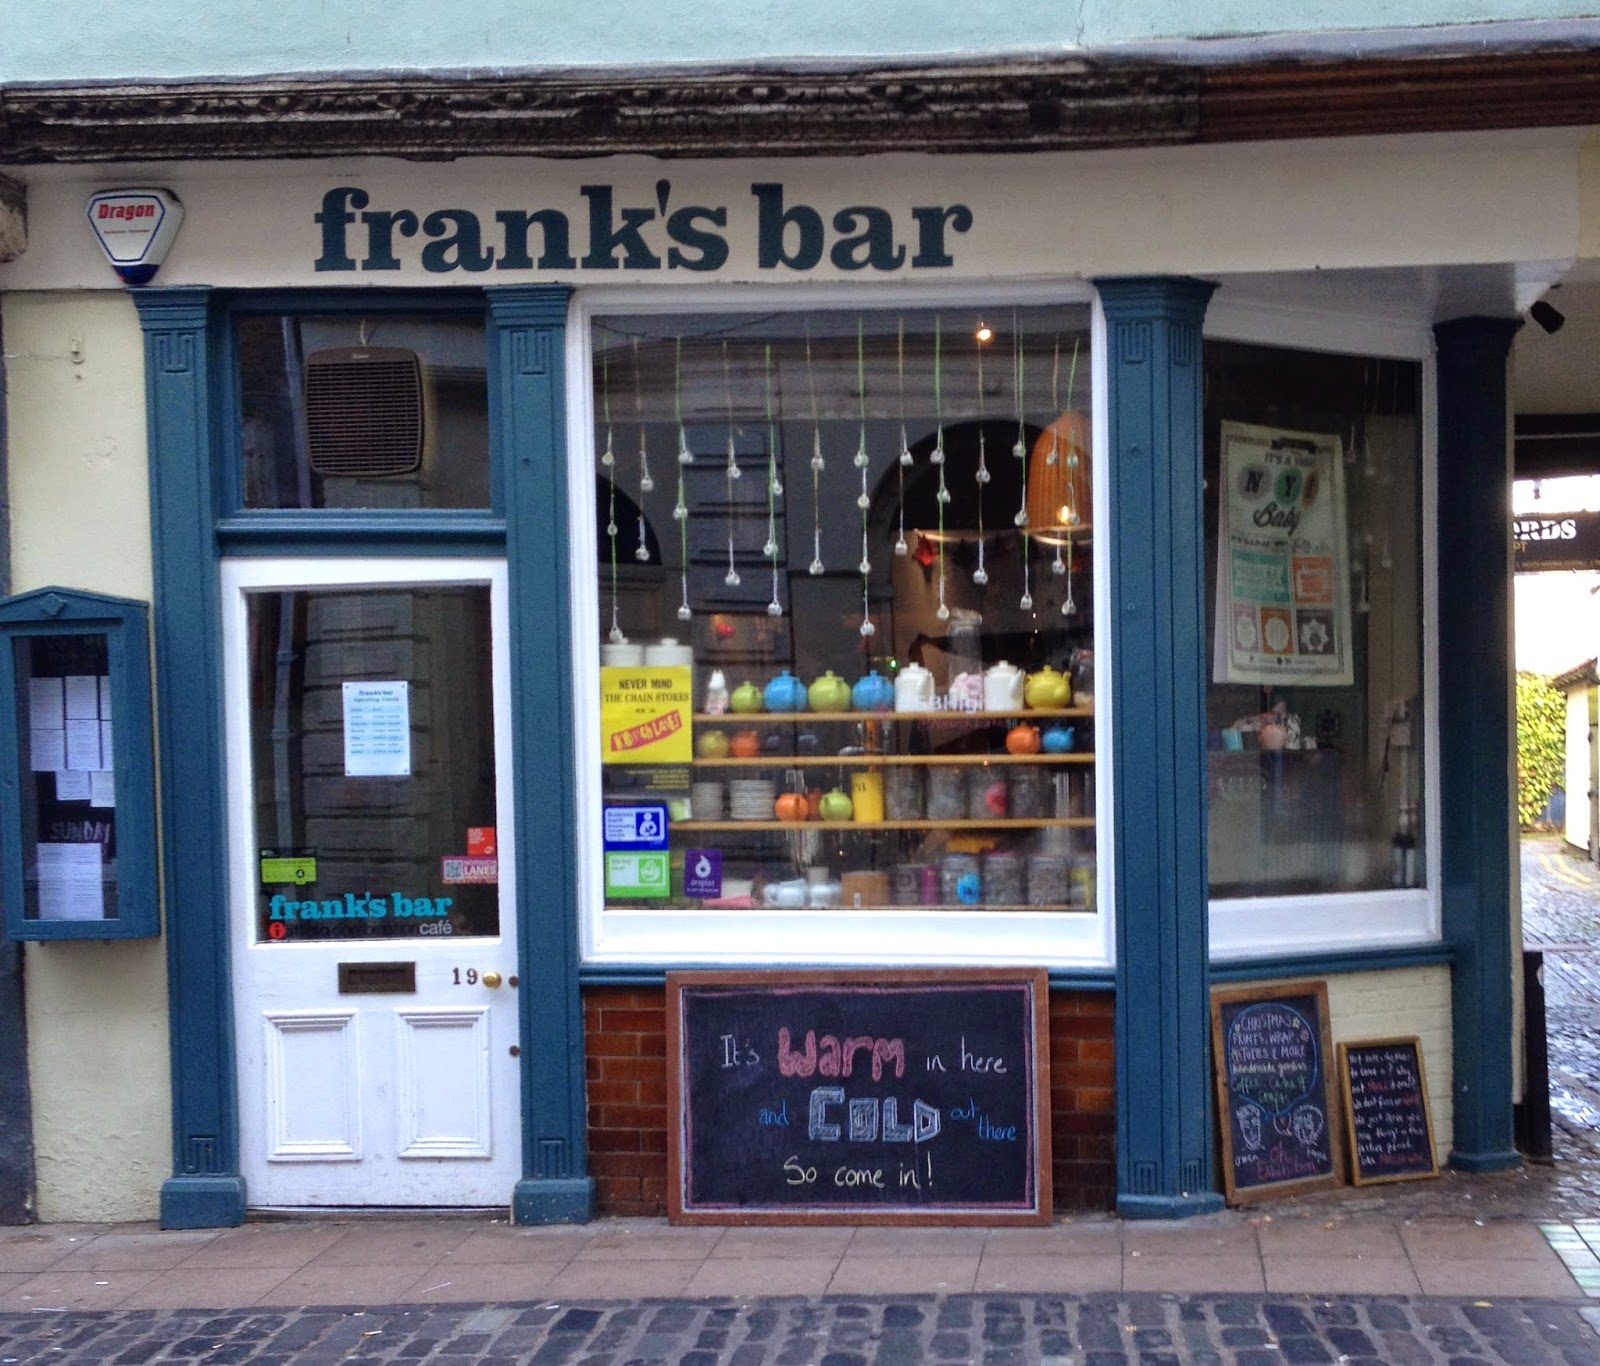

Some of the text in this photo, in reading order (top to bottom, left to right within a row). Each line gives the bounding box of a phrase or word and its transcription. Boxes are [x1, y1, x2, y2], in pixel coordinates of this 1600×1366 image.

[98, 203, 155, 220] Dragon
[314, 178, 973, 272] frank's bar
[619, 678, 673, 690] NEVER MIND
[605, 691, 690, 703] THE CHAIN STORES
[269, 891, 453, 921] frank's bar
[419, 919, 453, 935] café
[453, 967, 478, 985] 19
[1240, 1013, 1292, 1031] CHRISTMAS
[720, 1026, 1008, 1082] It's Warm in here
[1281, 1045, 1305, 1059] MORE
[758, 1086, 1017, 1143] and COLD out there
[783, 1155, 817, 1186] So
[834, 1164, 886, 1188] come
